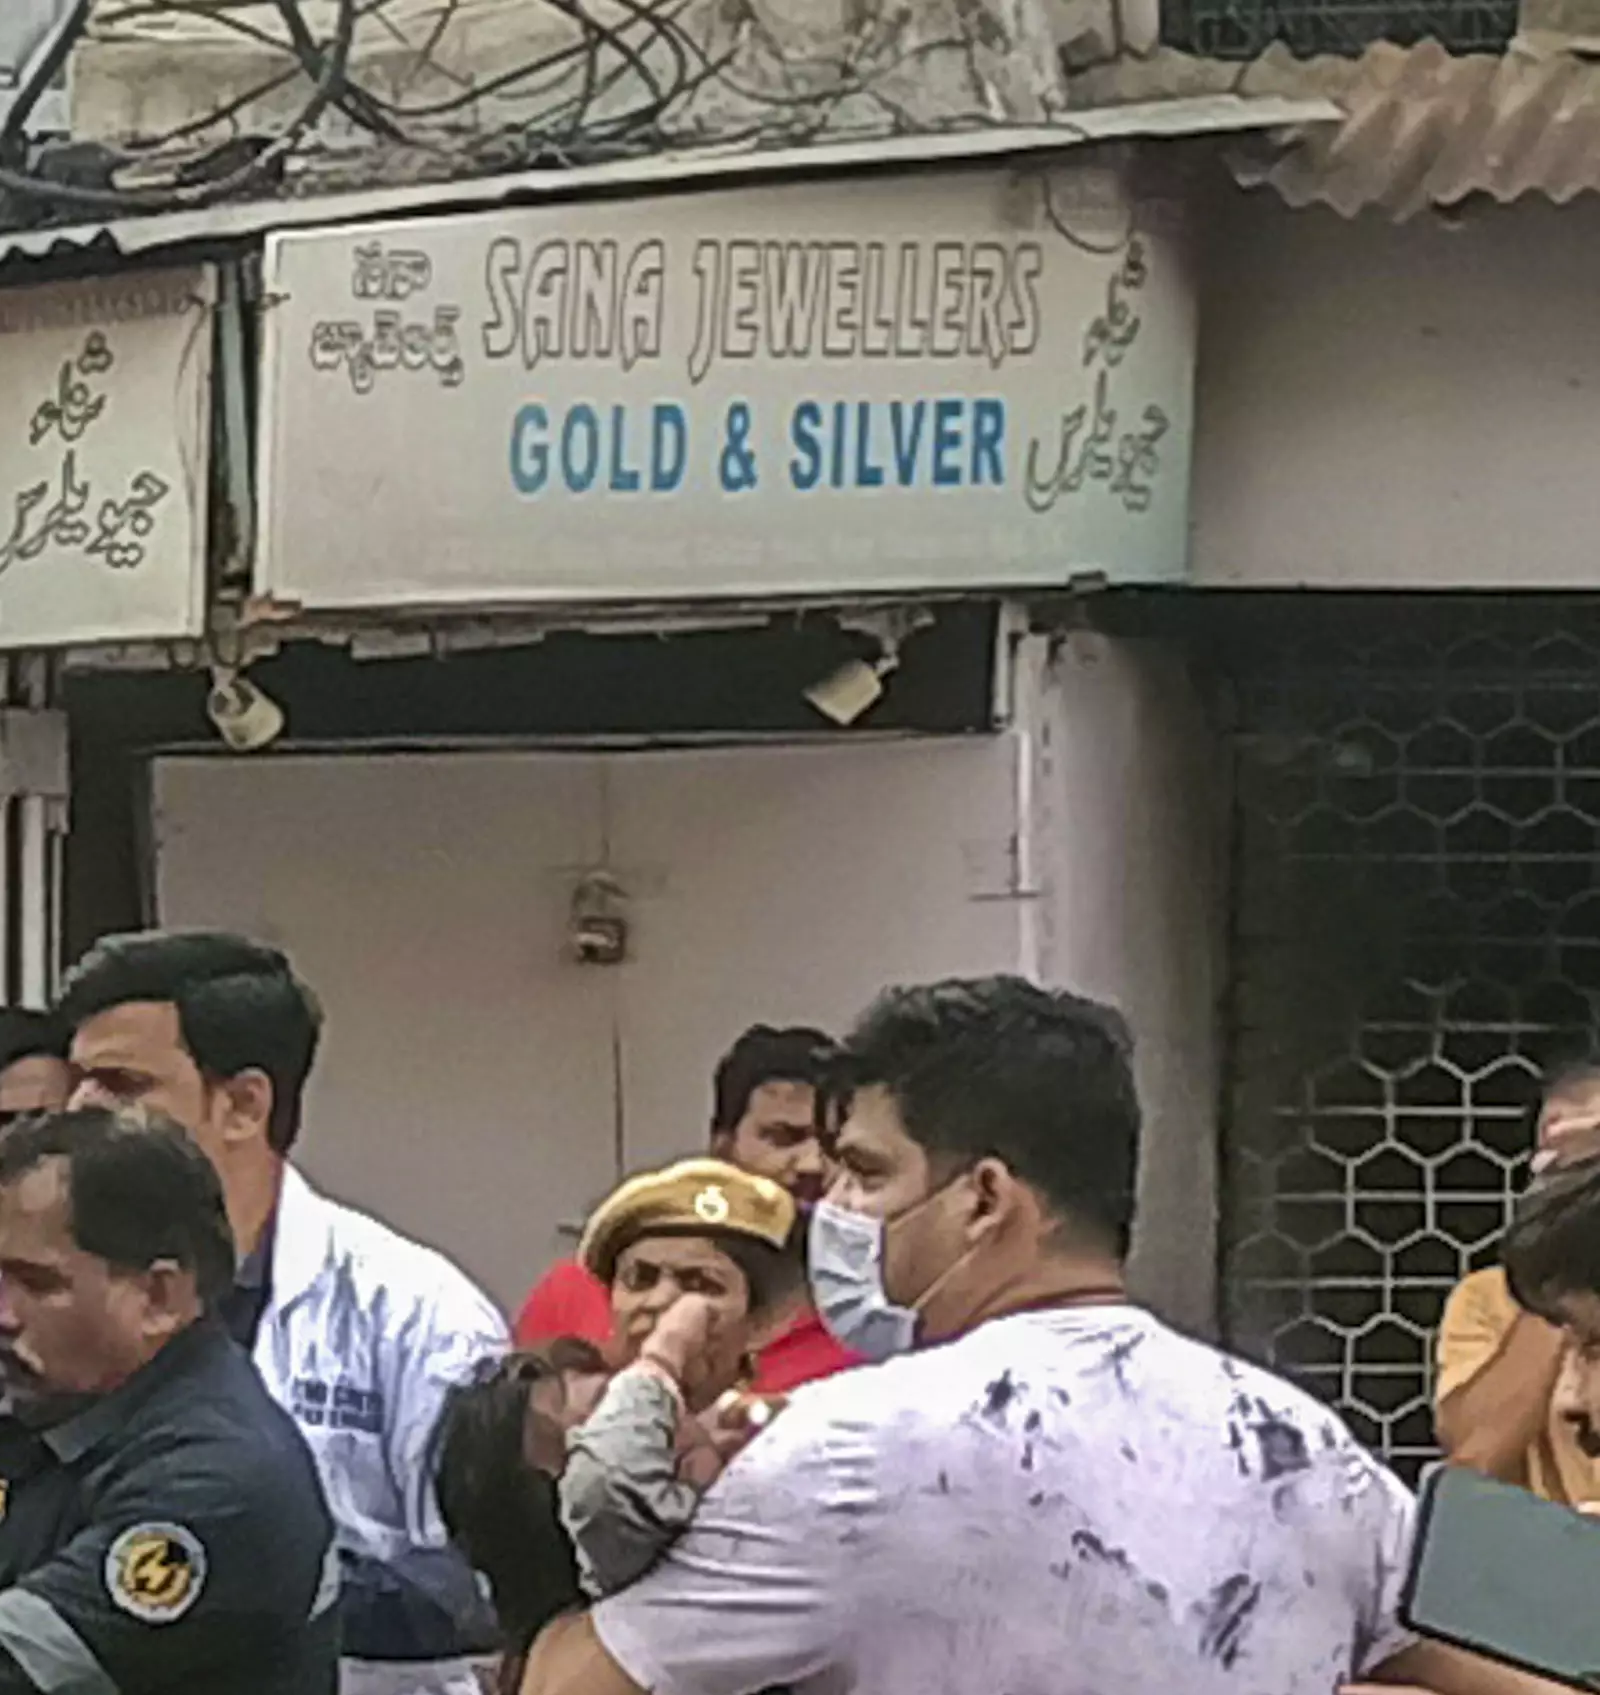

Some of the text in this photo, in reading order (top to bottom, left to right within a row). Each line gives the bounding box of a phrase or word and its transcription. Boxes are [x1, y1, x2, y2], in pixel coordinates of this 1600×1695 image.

[483, 238, 1043, 383] SANA JEWELLERS
[509, 398, 1005, 492] GOLD & SILVER
